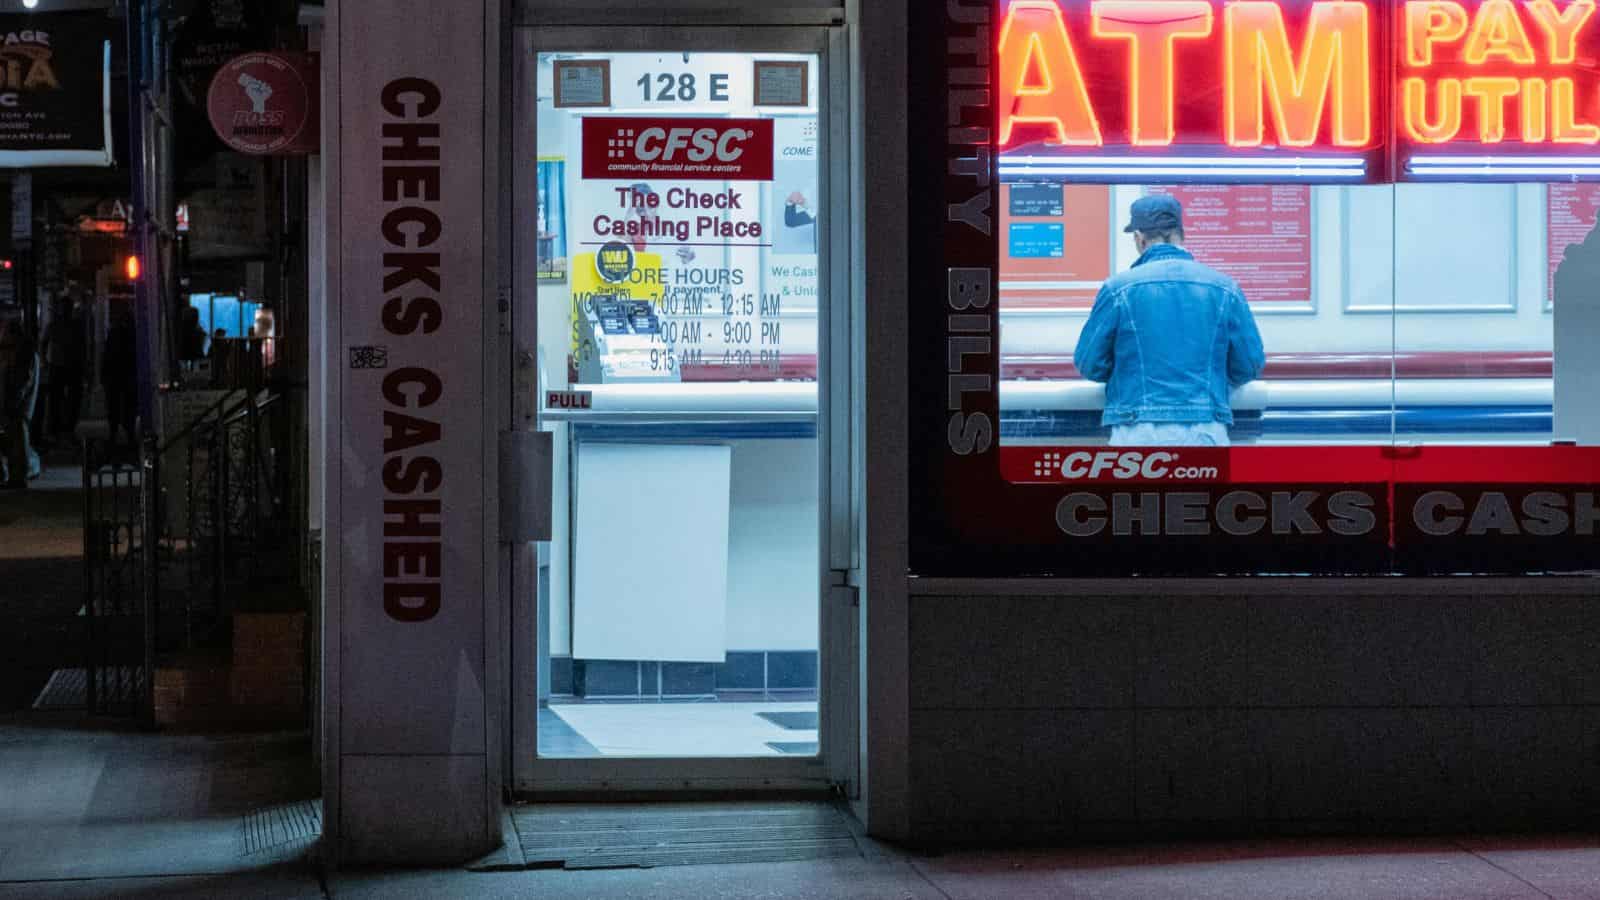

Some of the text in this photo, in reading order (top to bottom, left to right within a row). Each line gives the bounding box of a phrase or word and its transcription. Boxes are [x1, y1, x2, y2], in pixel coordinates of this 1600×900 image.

[1405, 0, 1597, 67] PAY
[998, 0, 1371, 147] ATM
[637, 73, 697, 101] 128
[709, 73, 729, 101] E
[1404, 77, 1600, 144] UTIL
[782, 146, 813, 156] COME
[607, 162, 742, 173] community financial service centers
[615, 187, 742, 209] The Check
[593, 214, 762, 242] Cashing Place
[675, 268, 744, 285] HOURS
[650, 293, 677, 315] 7:00
[682, 293, 703, 315] AM
[720, 293, 753, 316] 12:15
[760, 293, 780, 316] AM
[681, 321, 701, 344] AM
[723, 321, 751, 344] 9:00
[761, 321, 780, 345] PM
[381, 76, 443, 623] CHECKS CASHED
[650, 350, 674, 371] 9:15
[947, 266, 991, 455] BILLS
[549, 394, 590, 408] PULL
[1055, 491, 1375, 537] CHECKS
